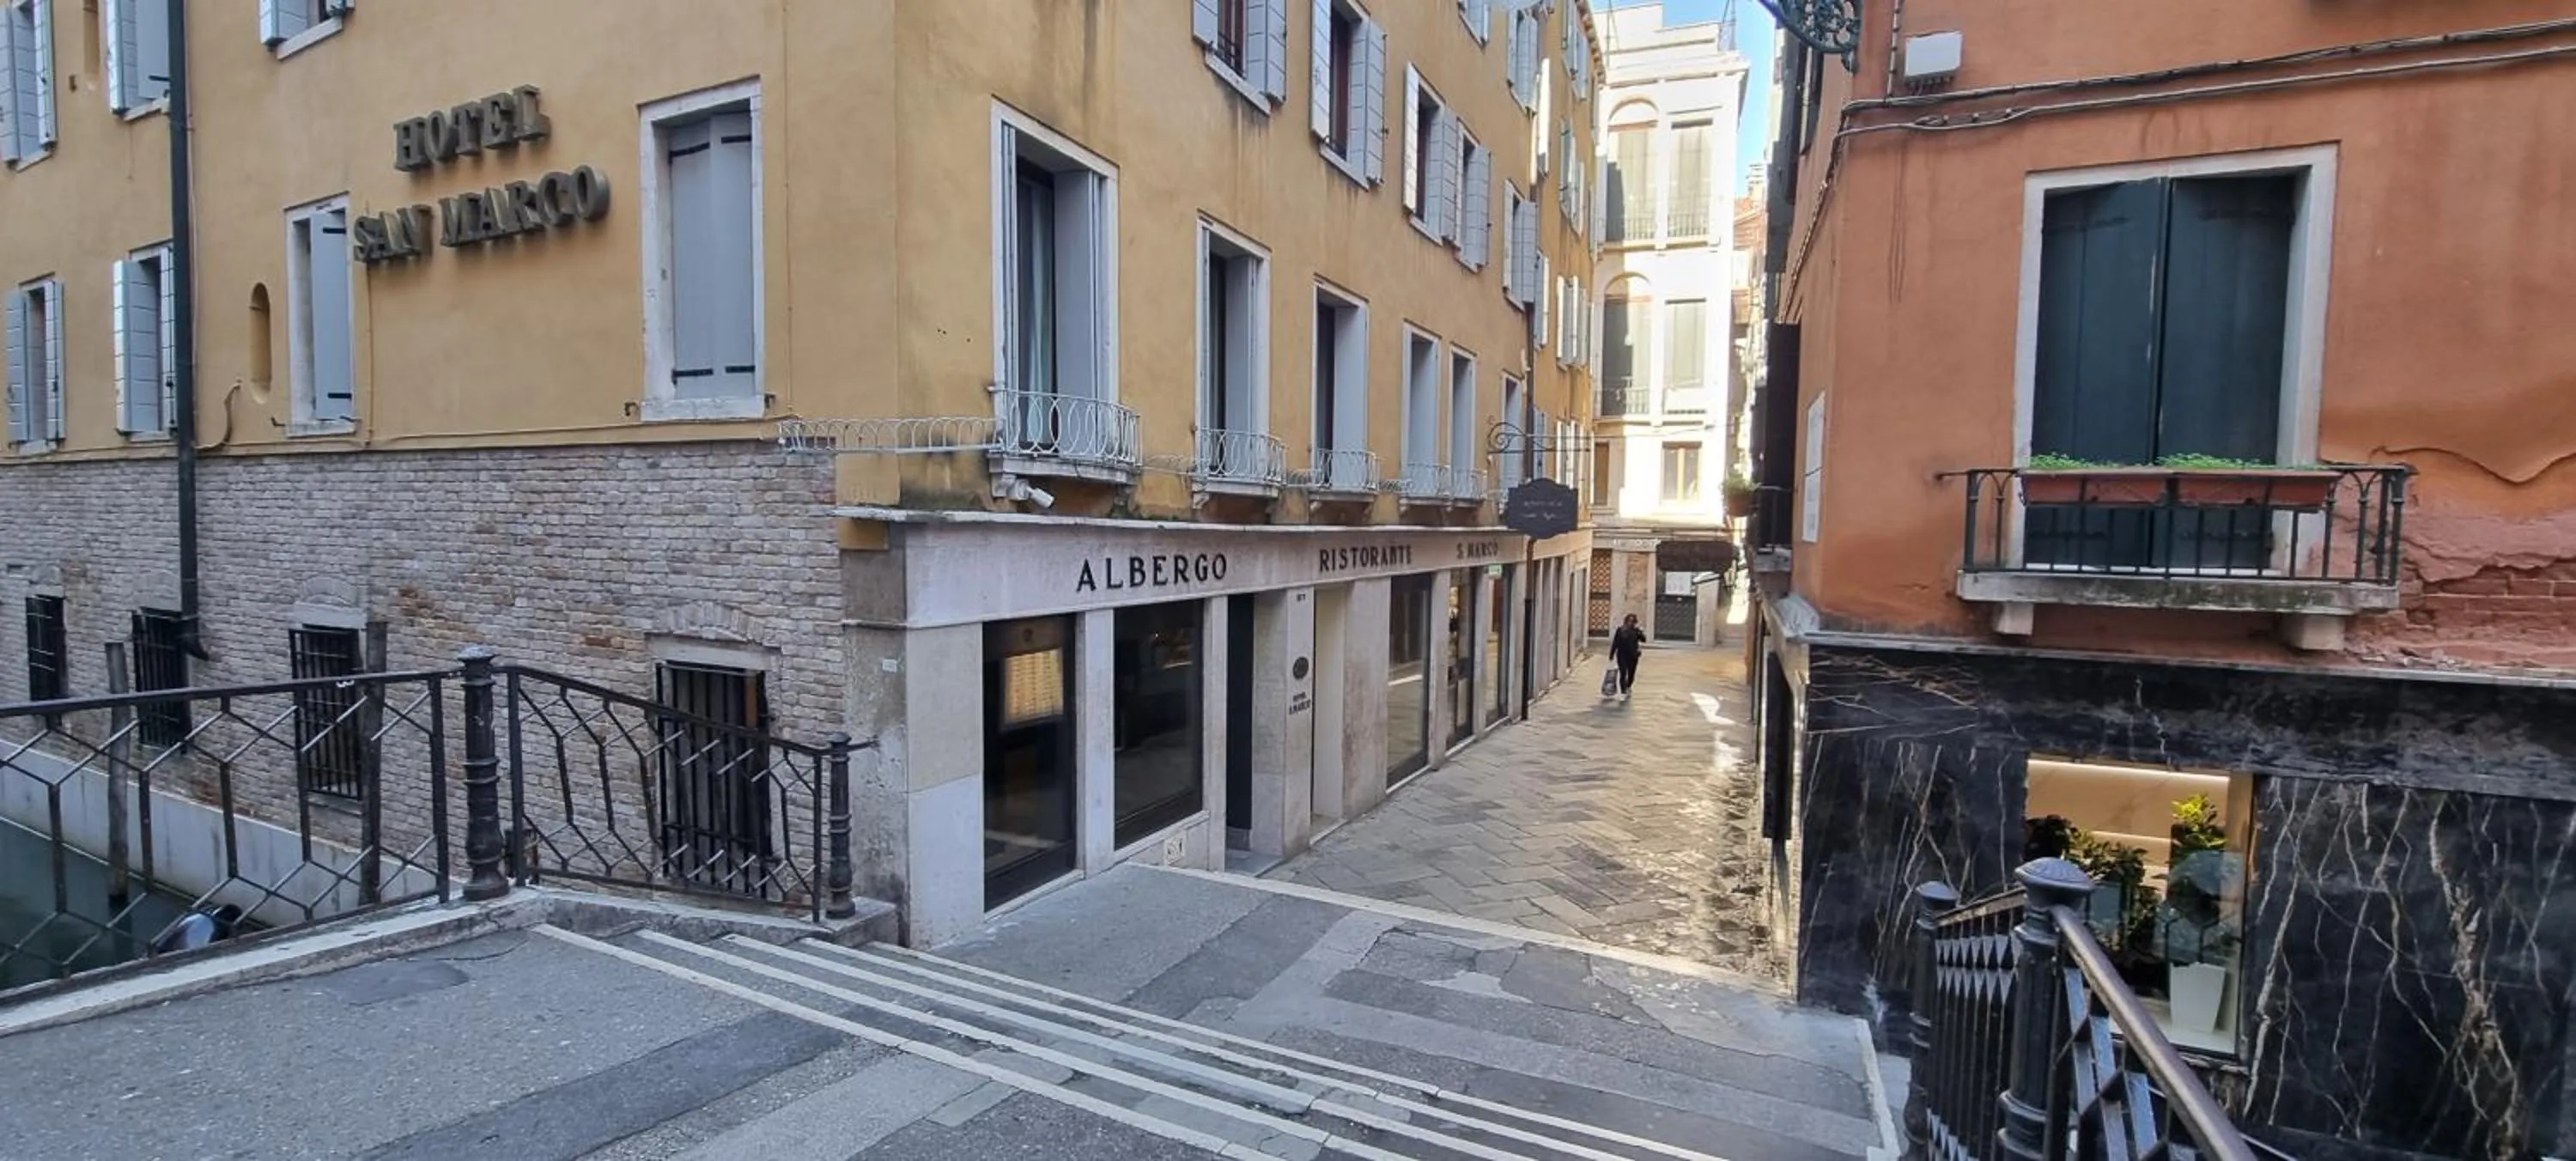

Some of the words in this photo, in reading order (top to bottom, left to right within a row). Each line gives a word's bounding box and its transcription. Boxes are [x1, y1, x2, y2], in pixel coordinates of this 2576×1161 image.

[393, 84, 551, 172] HOTEL
[354, 204, 432, 263] SAN
[439, 164, 611, 247] MARCO
[1076, 554, 1227, 592] ALBERGO
[1319, 544, 1412, 573] RISTORANTE
